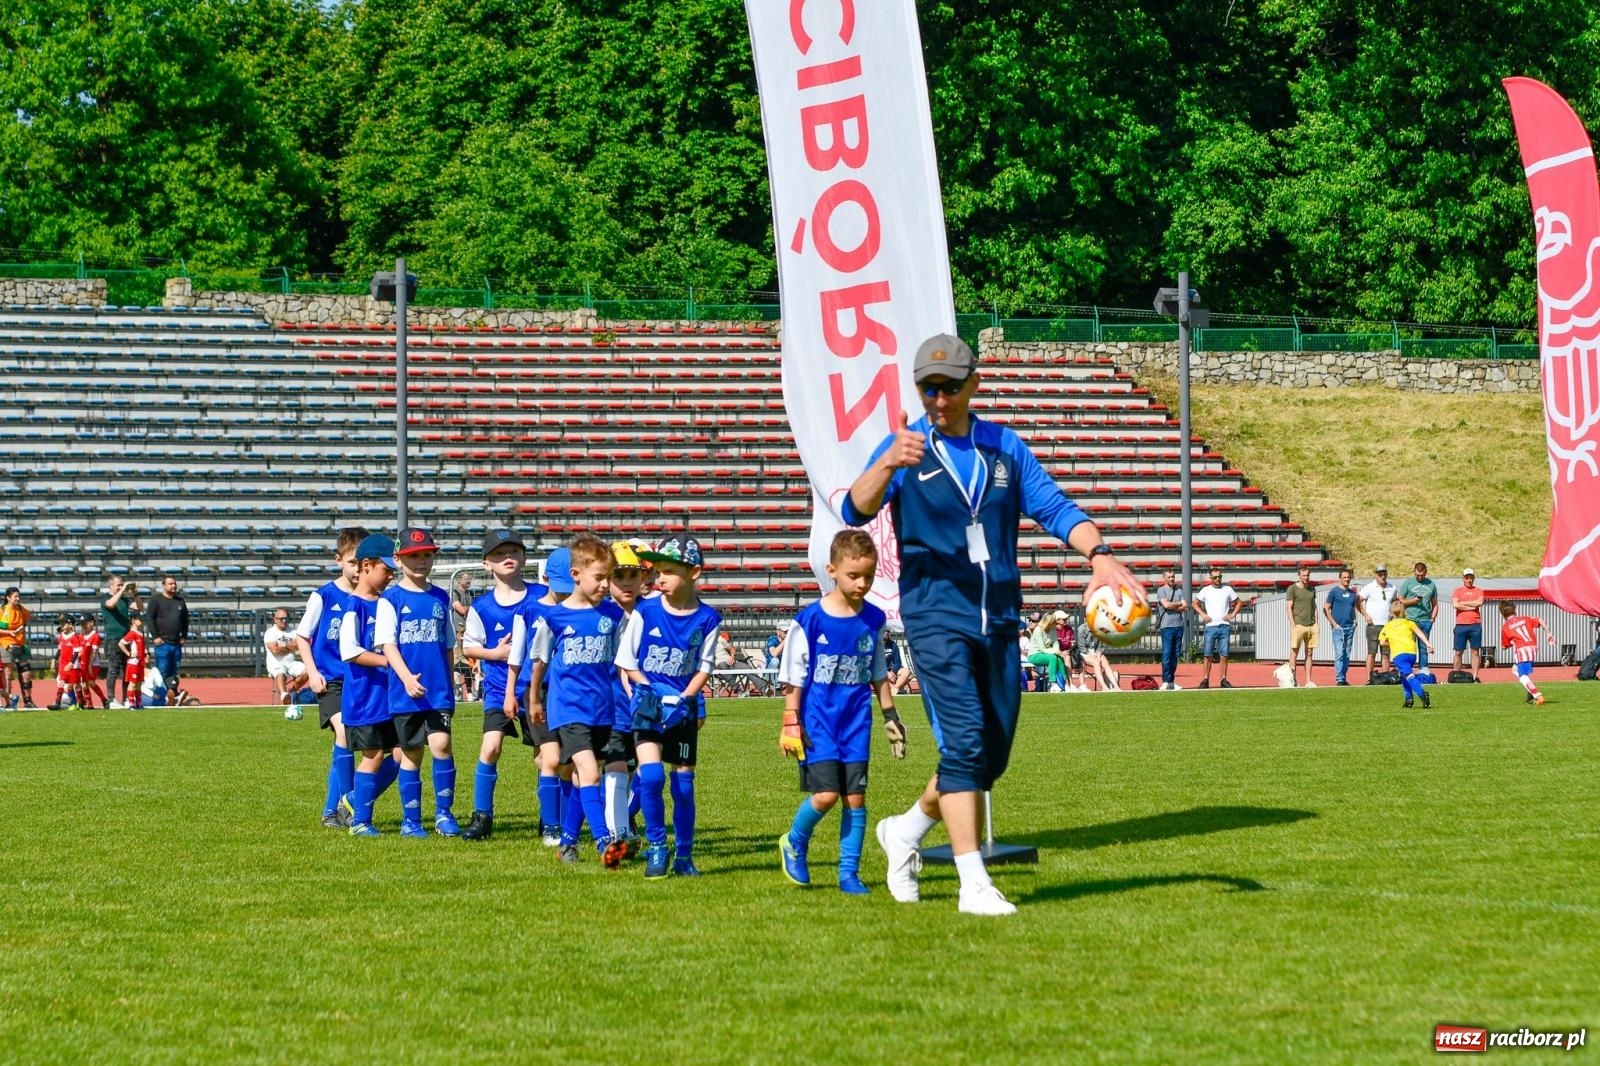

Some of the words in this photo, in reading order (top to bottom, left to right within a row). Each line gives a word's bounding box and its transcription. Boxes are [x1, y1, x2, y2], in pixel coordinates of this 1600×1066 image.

[399, 630, 445, 645] ENGLA
[562, 649, 613, 666] ENGLA
[678, 741, 690, 759] 10
